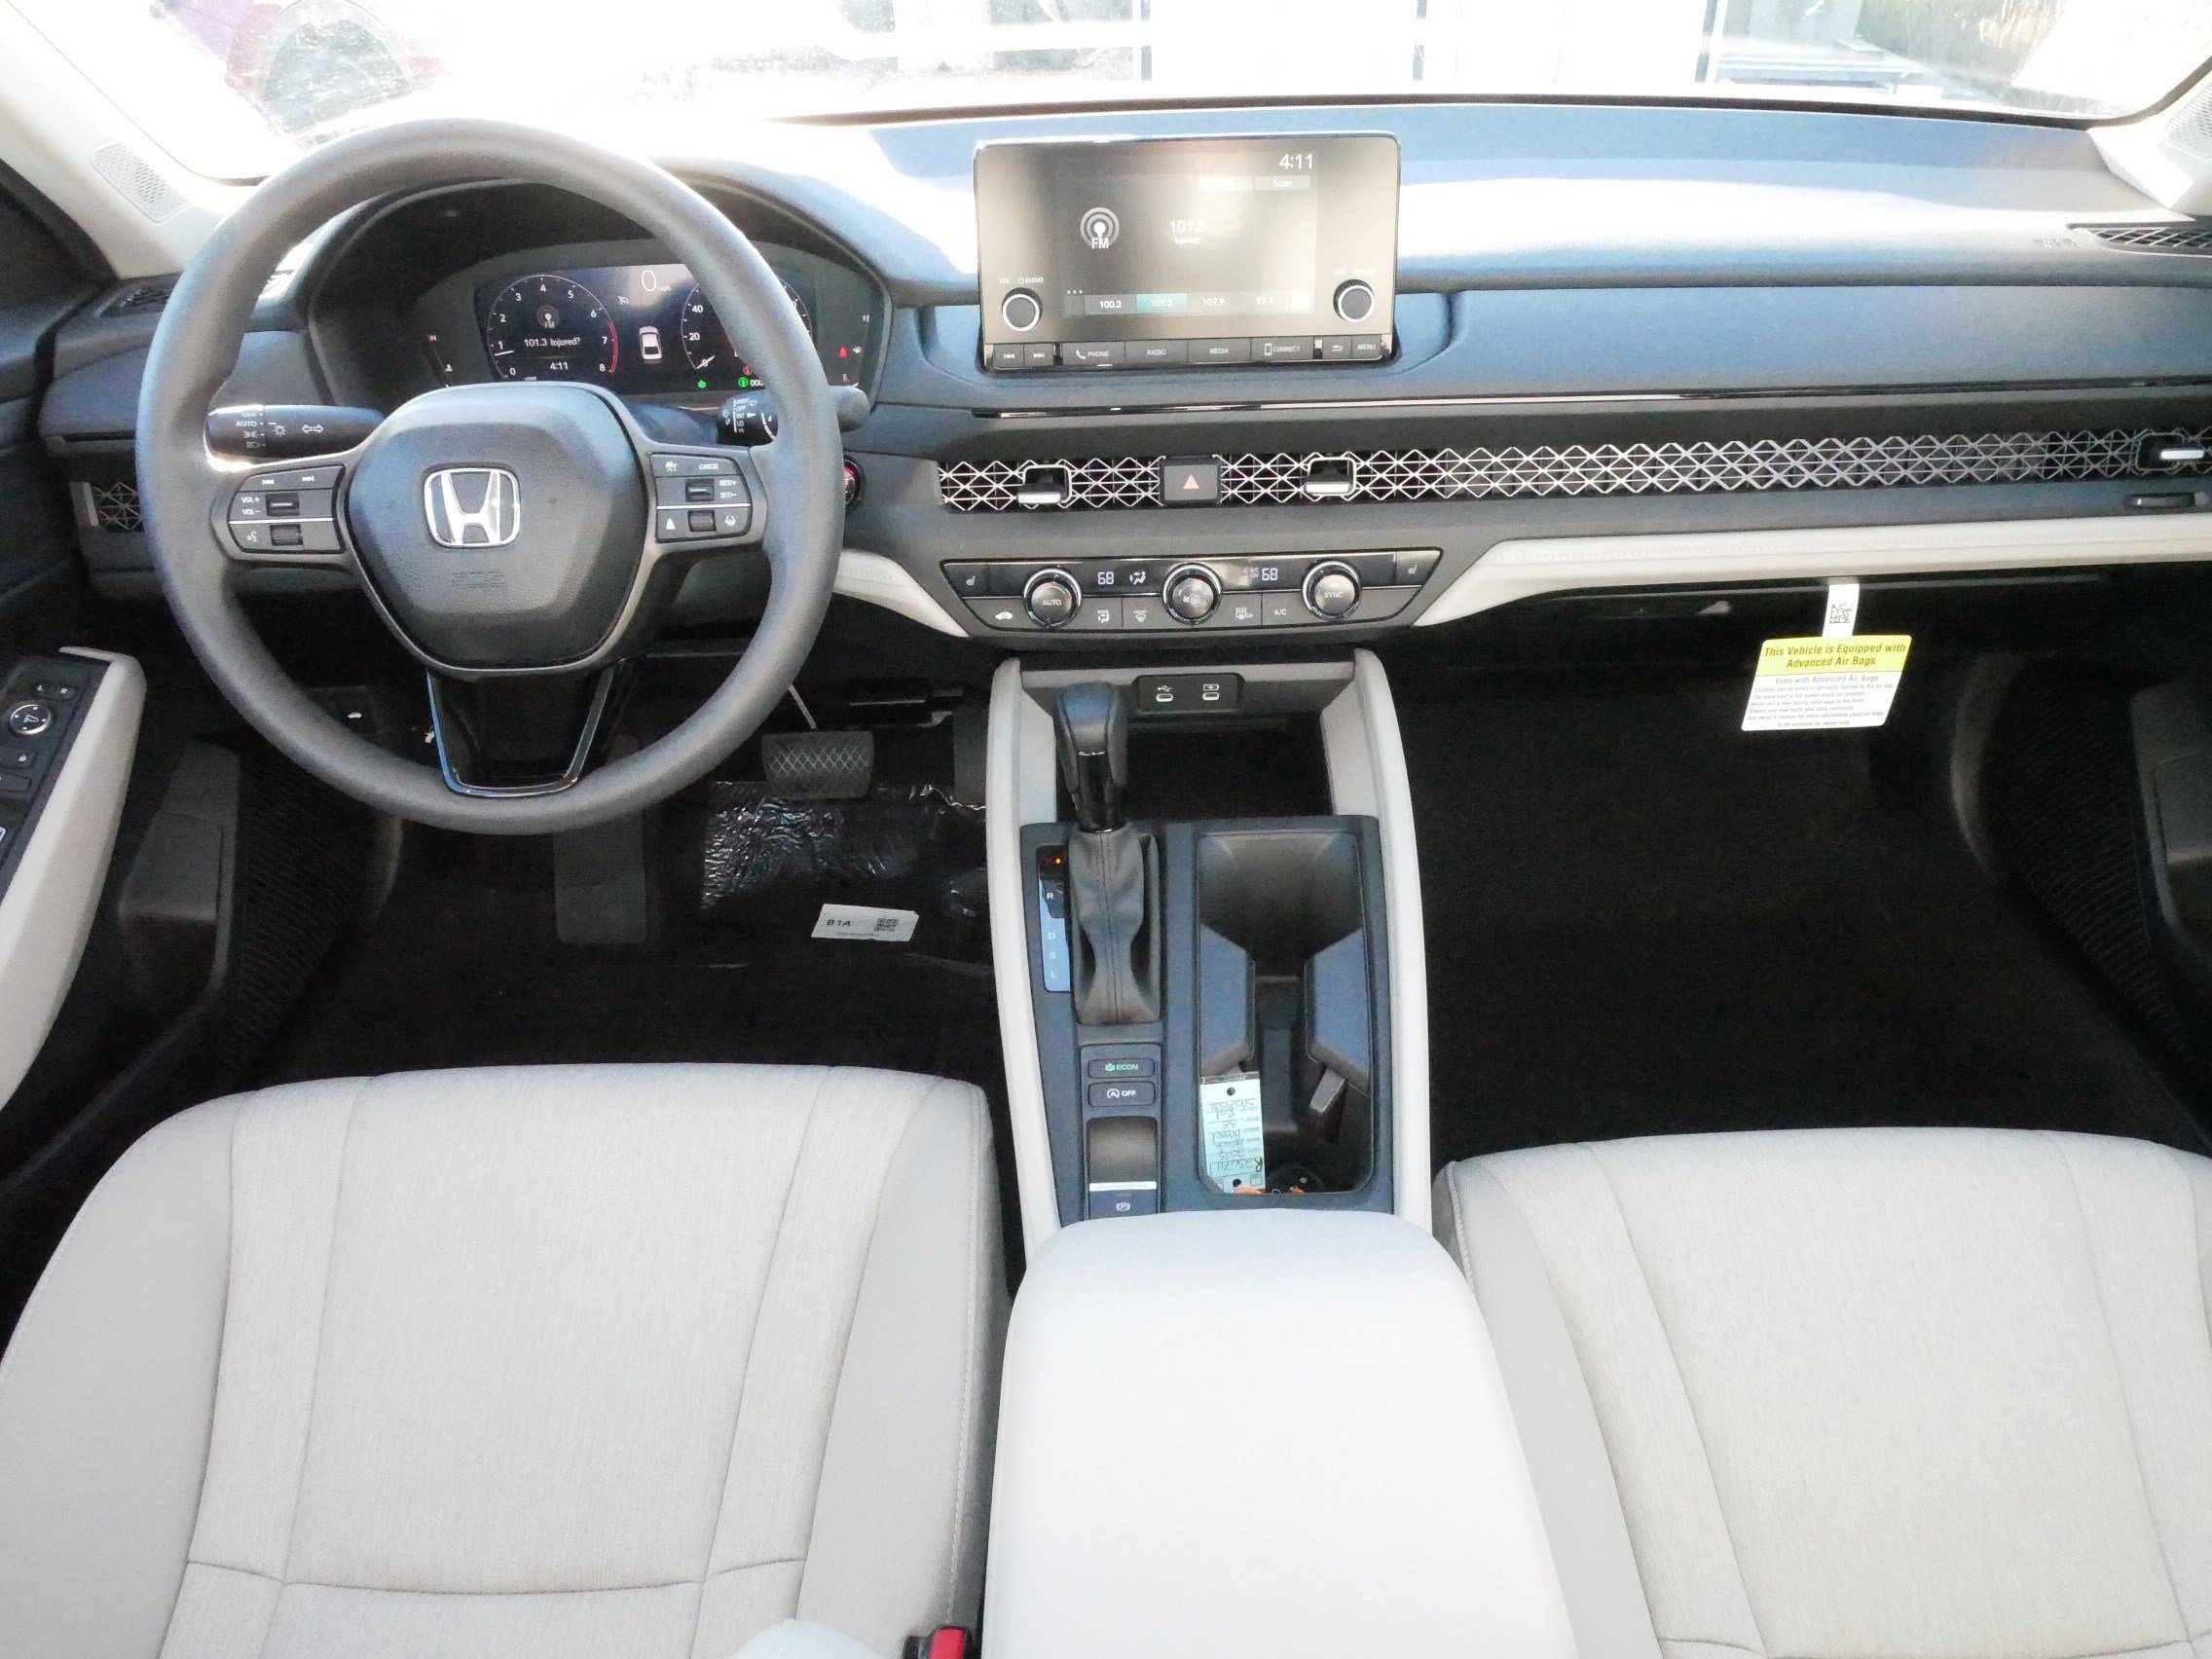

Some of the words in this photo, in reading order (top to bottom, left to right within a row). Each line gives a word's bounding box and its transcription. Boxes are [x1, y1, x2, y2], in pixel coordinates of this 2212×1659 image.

[1278, 153, 1313, 169] 4:11
[1272, 178, 1293, 188] Scan
[1170, 219, 1206, 234] 101.3
[1091, 238, 1109, 249] FM
[642, 270, 657, 292] 0
[540, 284, 547, 293] 4
[515, 293, 522, 302] 3
[568, 290, 574, 299] 5
[691, 304, 704, 313] 40
[1099, 300, 1123, 309] 100.3
[1151, 298, 1174, 308] 101.3
[499, 313, 506, 323] 2
[590, 310, 597, 318] 6
[688, 332, 701, 341] 20
[498, 341, 503, 350] 1
[524, 338, 547, 348] 101.3
[550, 337, 581, 349] Injured?
[1357, 343, 1377, 351] MENU
[1273, 345, 1300, 353] CONNECT
[550, 361, 569, 371] 4:11
[599, 363, 606, 372] 8
[509, 367, 516, 376] 0
[1097, 571, 1114, 584] 68
[1262, 568, 1278, 581] 68
[1765, 647, 1784, 657] This
[1788, 645, 1823, 655] Vehicle
[1825, 645, 1833, 654] is
[1836, 644, 1882, 655] Equipped
[1885, 644, 1905, 652] with
[1787, 657, 1832, 668] Advanced
[1835, 657, 1849, 666] Air
[1852, 656, 1876, 667] Bags
[1812, 675, 1846, 683] Advanced
[1862, 674, 1879, 682] Bags
